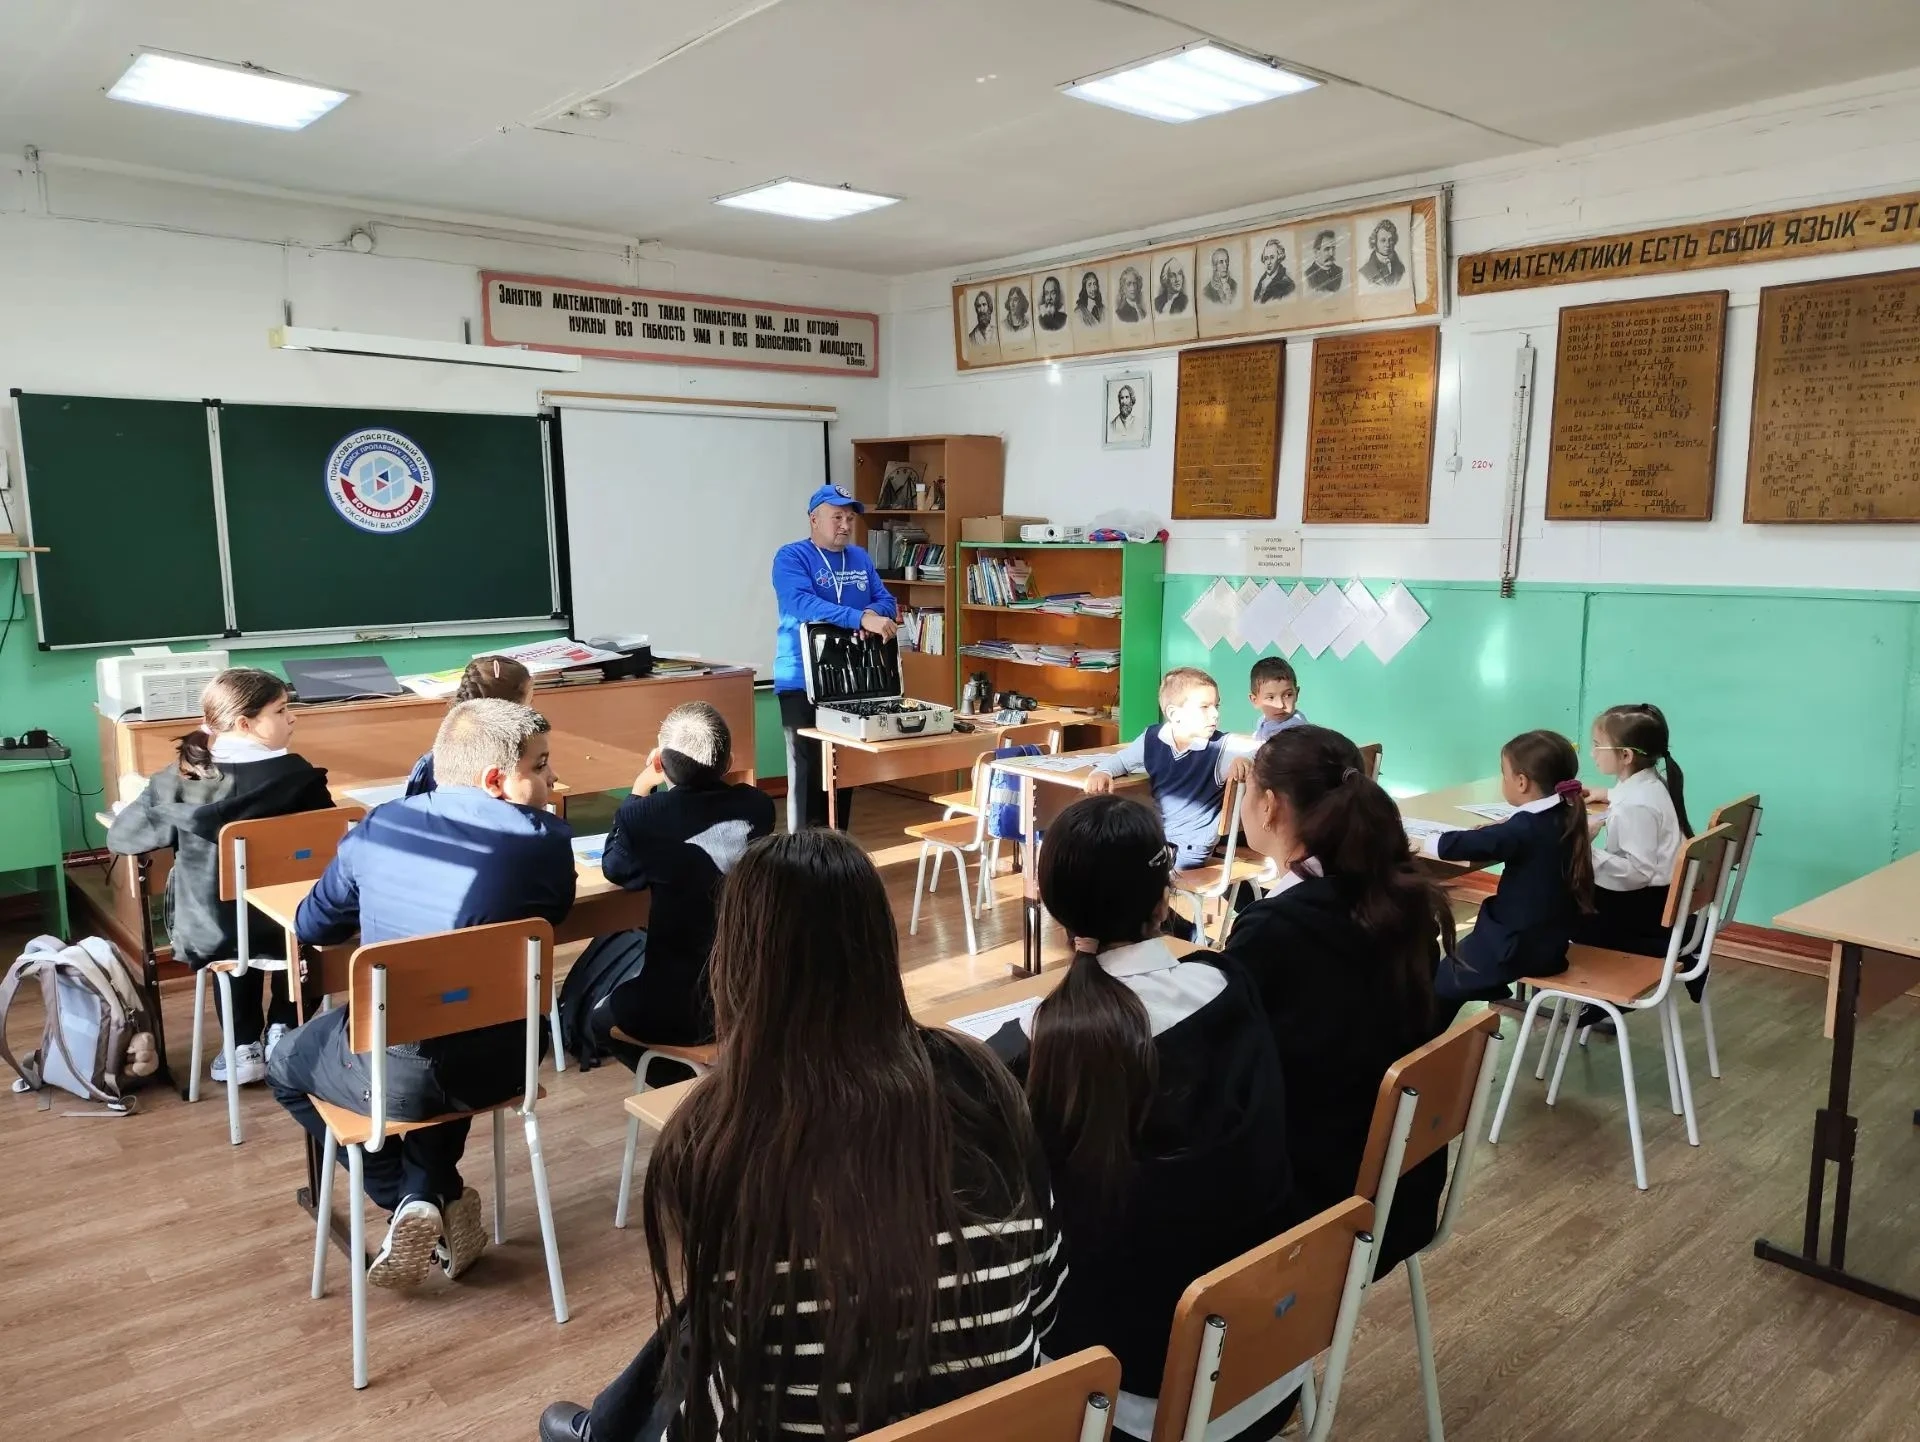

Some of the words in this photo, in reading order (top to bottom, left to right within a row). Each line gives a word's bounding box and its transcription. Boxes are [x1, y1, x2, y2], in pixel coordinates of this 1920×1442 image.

[1472, 262, 1486, 284] У
[1493, 242, 1633, 281] МАТЕМАТИКИ
[1640, 234, 1698, 264] ЕСТЬ
[1708, 220, 1776, 255] СВОЙ
[1784, 210, 1861, 246] ЯЗЫК
[1881, 203, 1920, 232] ЭТ
[658, 304, 686, 321] ТАКАЯ
[693, 308, 747, 328] ГИМНАСТИКА
[784, 318, 799, 333] ДЛЯ
[569, 316, 606, 334] НУЖНЫ
[615, 321, 633, 336] ВСЯ
[642, 323, 686, 341] ГИБКОСТЬ
[693, 328, 711, 344] УМА
[719, 331, 725, 345] И
[732, 333, 748, 347] ВСЯ
[756, 334, 812, 352] ВЫНОСЛИВОСТЬ
[820, 340, 865, 357] МОЛОДОСТИ.
[330, 433, 418, 481] ПОИСКОВО-СПАСАТЕЛЬНЫЙ
[416, 457, 430, 482] ОТРЯД
[343, 450, 361, 469] ПОИСК
[360, 444, 402, 456] ПРОПАВШИХ
[401, 454, 418, 473] ДЕТЕЙ
[344, 506, 378, 529] ОКСАНЫ
[351, 498, 392, 519] БОЛЬШАЯ
[393, 499, 417, 517] МУРТА
